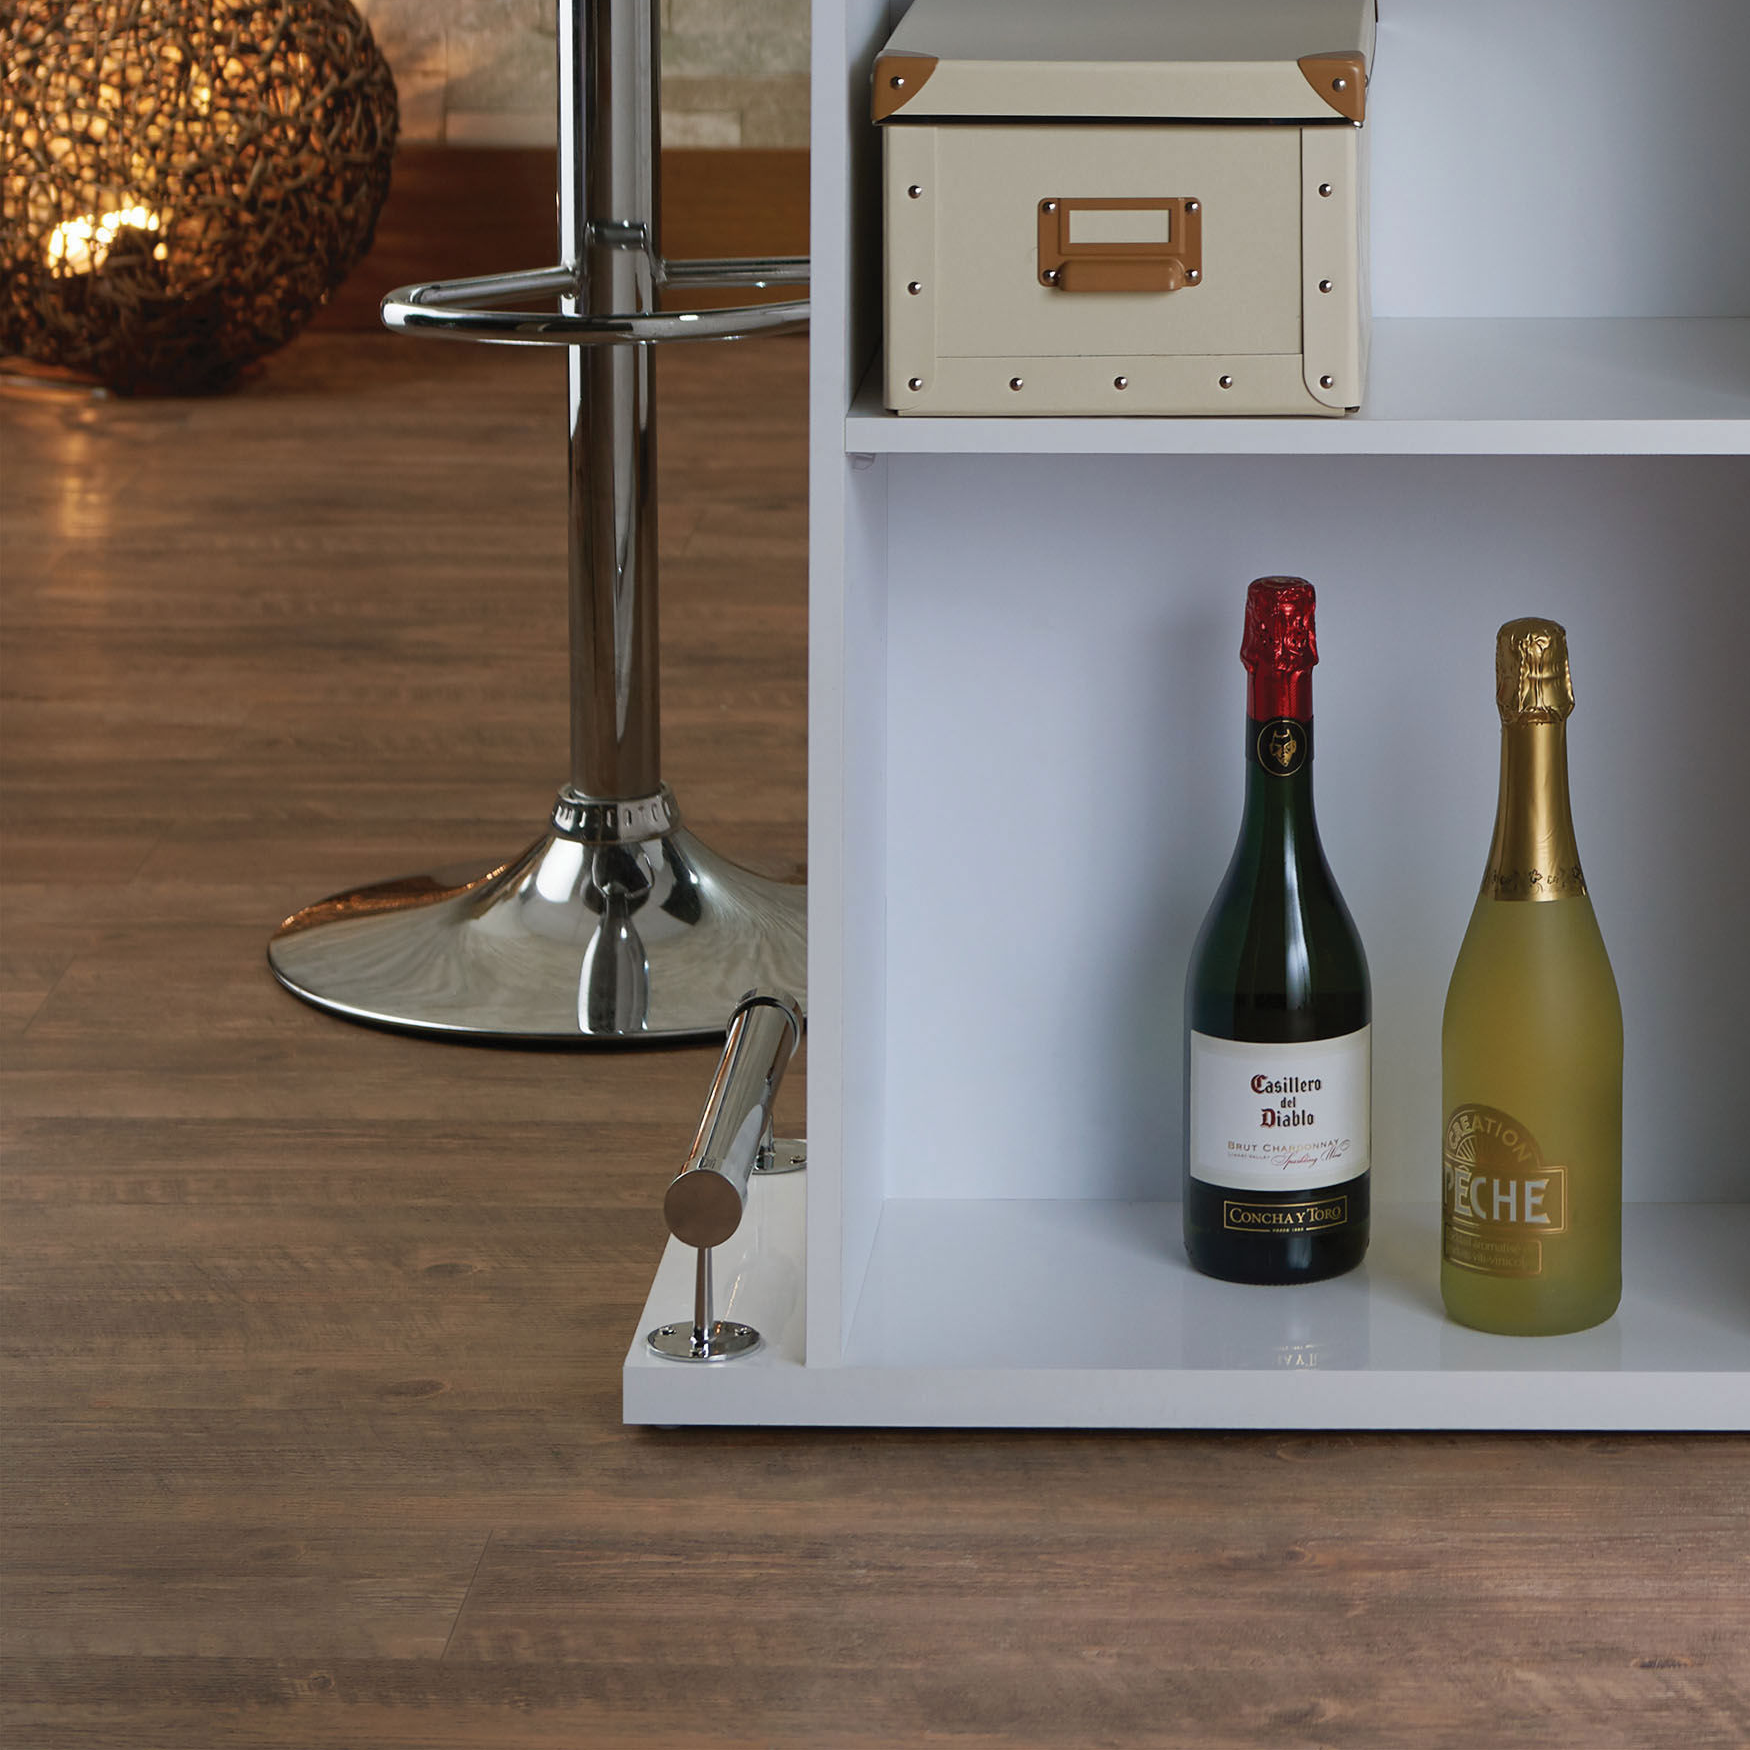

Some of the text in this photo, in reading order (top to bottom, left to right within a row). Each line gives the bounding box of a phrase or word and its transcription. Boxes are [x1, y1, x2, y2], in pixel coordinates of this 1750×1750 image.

[1250, 1074, 1322, 1095] Casillero
[1280, 1097, 1296, 1109] del
[1260, 1108, 1315, 1128] Diablo
[1227, 1138, 1339, 1153] BRUT CHARDONNAY
[1229, 1207, 1294, 1225] CONCHA
[1306, 1205, 1342, 1223] TORO
